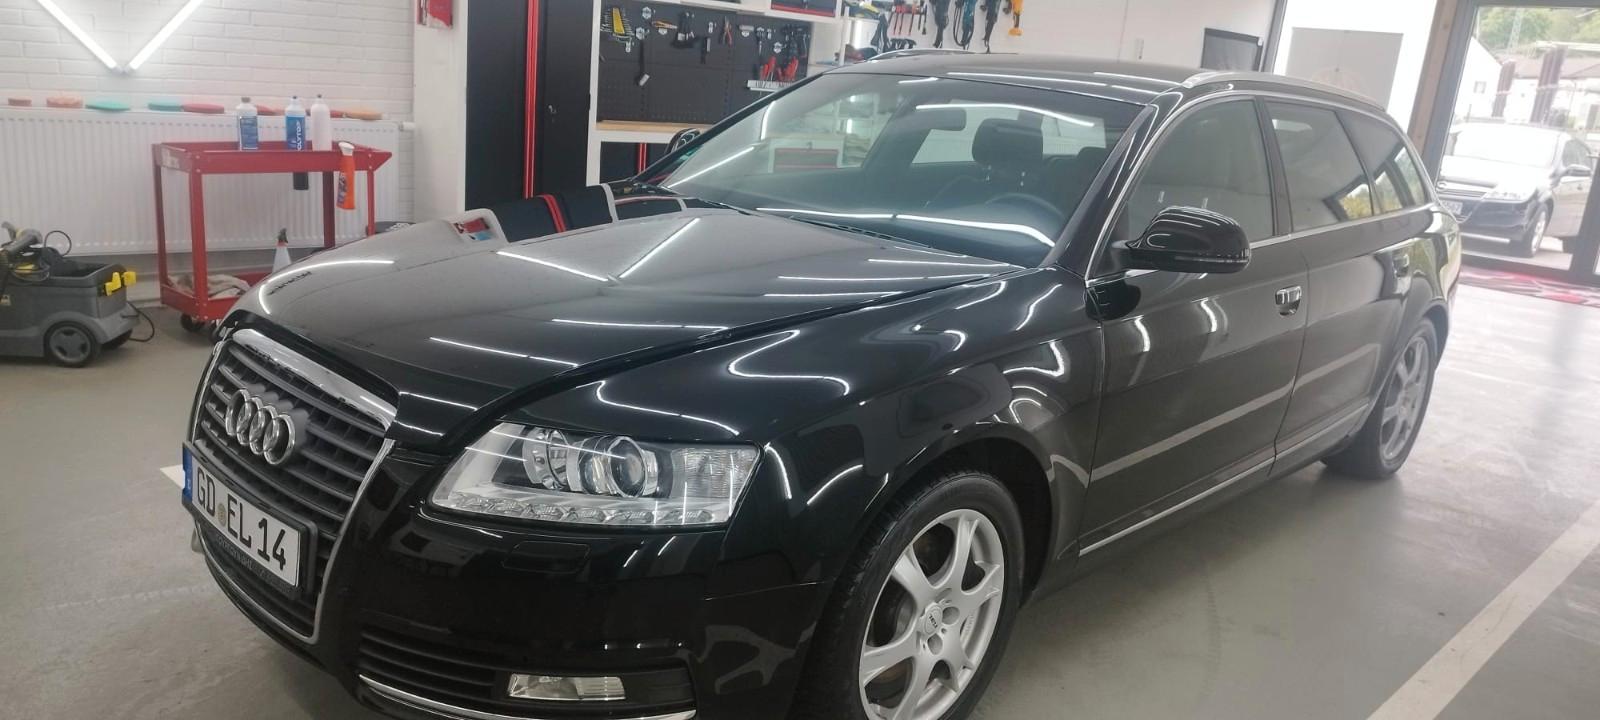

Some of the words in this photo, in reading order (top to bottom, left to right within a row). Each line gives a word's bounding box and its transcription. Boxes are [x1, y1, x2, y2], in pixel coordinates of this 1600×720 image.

[197, 466, 216, 517] GD
[227, 493, 252, 549] EL
[257, 517, 287, 571] 14
